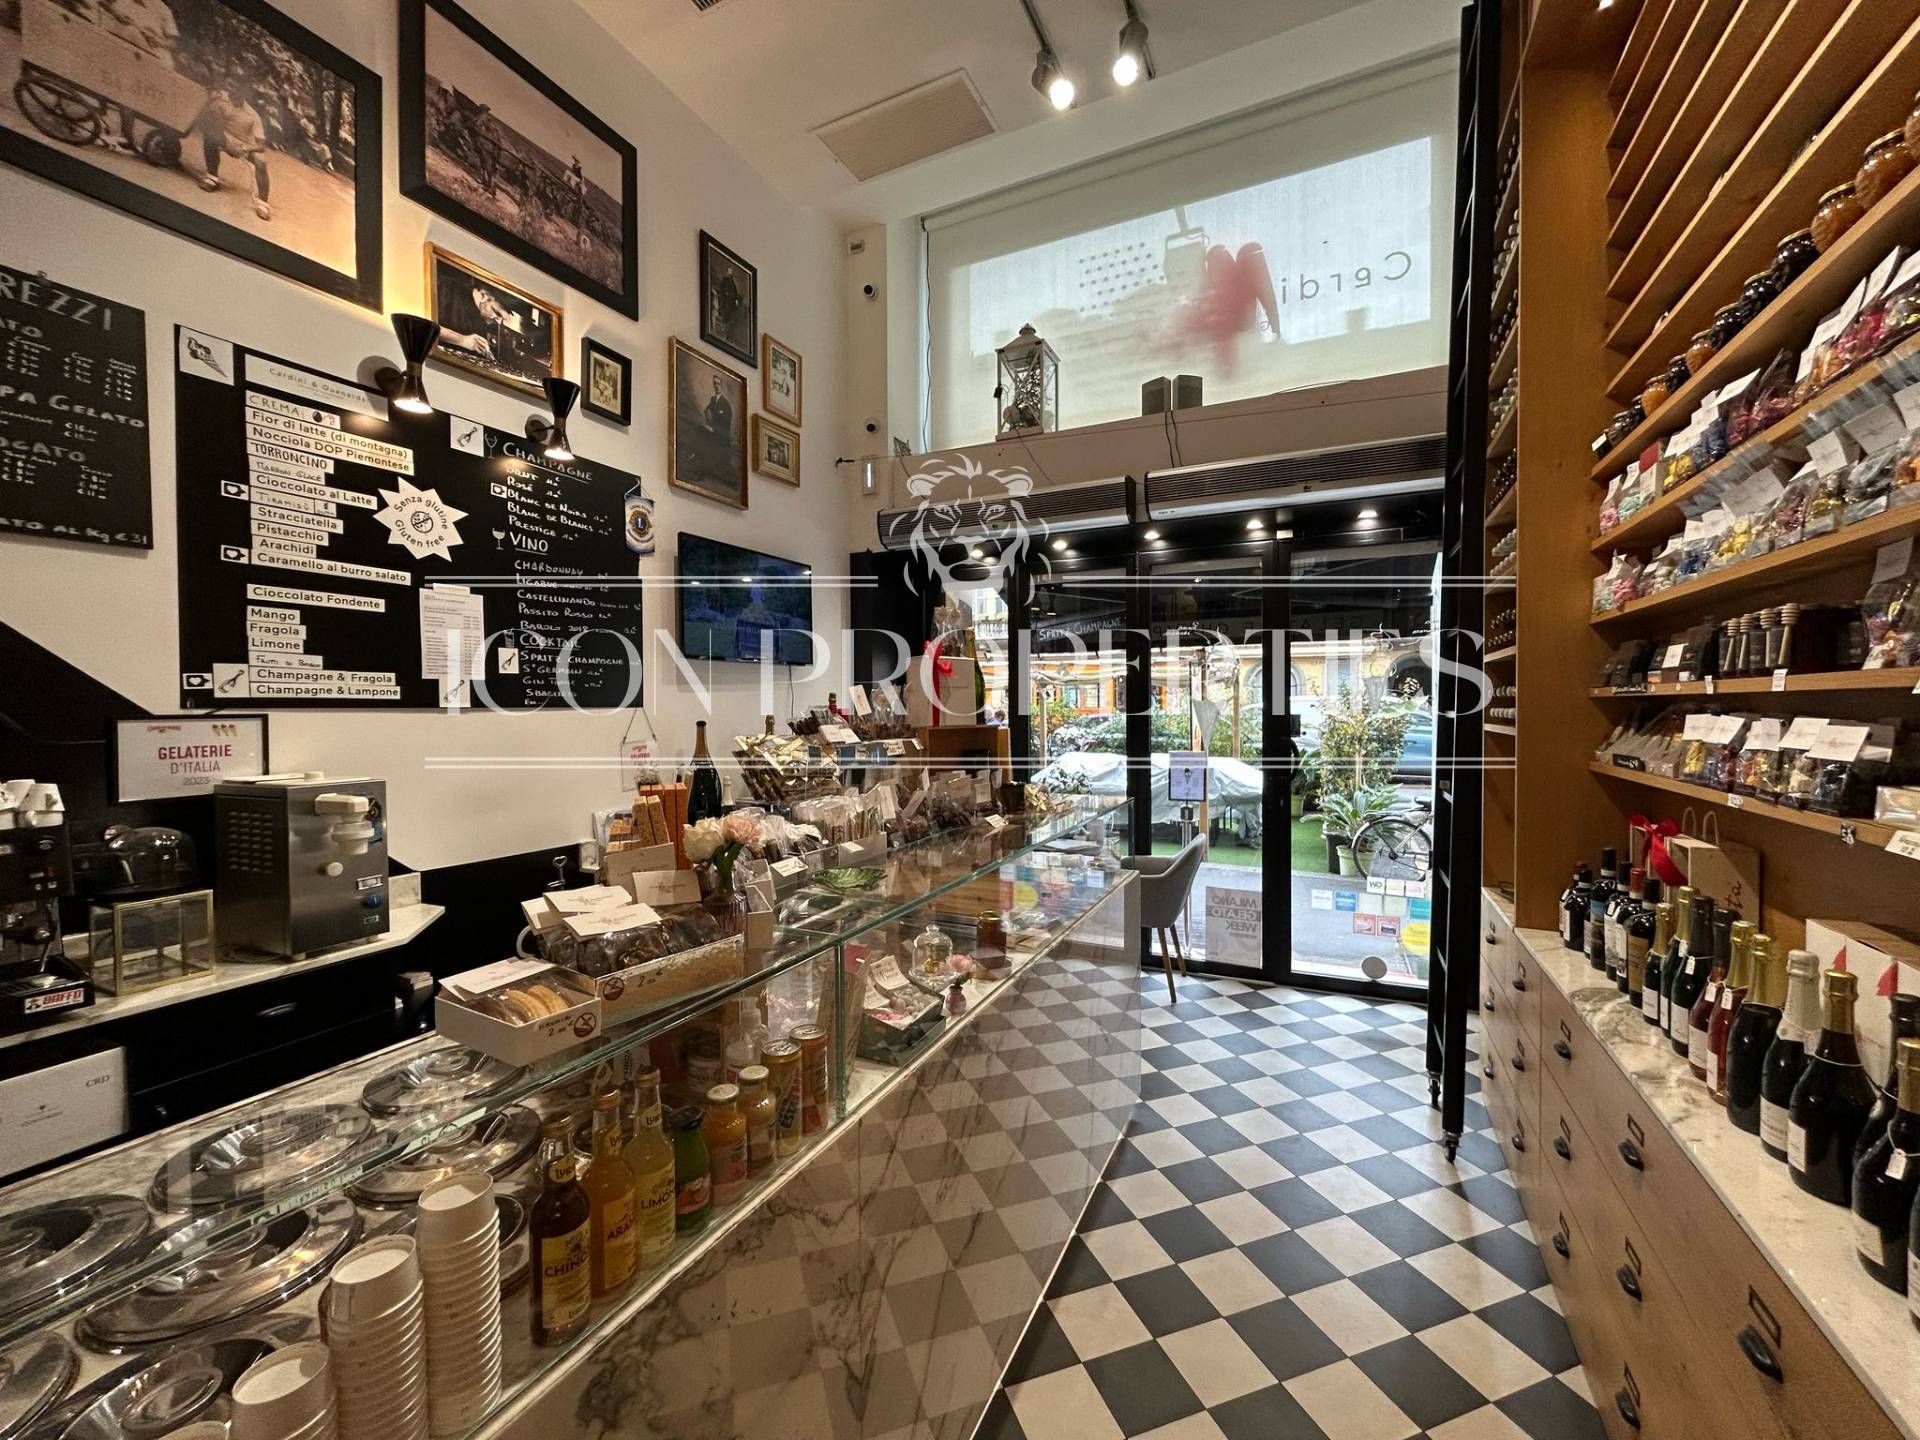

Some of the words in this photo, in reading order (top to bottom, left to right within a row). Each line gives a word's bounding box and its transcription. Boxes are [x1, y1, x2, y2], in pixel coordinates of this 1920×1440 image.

[249, 395, 300, 416] CREMA
[252, 411, 278, 425] Fior
[283, 419, 295, 430] di
[300, 424, 327, 438] latte
[331, 429, 346, 442] (di
[350, 437, 408, 458] montagna)
[250, 442, 328, 470] TORRONCINO
[252, 427, 311, 449] Nocciola
[314, 441, 343, 455] DOP
[346, 449, 410, 471] Piemontese
[256, 474, 326, 497] Cioccolato
[329, 489, 340, 500] al
[343, 493, 372, 506] Latte
[394, 496, 423, 512] Senza
[258, 507, 338, 530] Stracciatella
[424, 499, 448, 530] glutine
[257, 523, 324, 542] Pistacchio
[395, 519, 423, 548] Gluten
[425, 535, 445, 548] free
[510, 531, 548, 552] VINO
[259, 538, 314, 555] Arachidi
[257, 552, 323, 571] Caramello
[327, 561, 337, 572] al
[340, 563, 372, 577] burro
[375, 570, 407, 582] salato
[253, 586, 323, 603] Cioccolato
[327, 594, 381, 609] Fondente
[250, 607, 296, 624] Mango
[250, 622, 300, 639] Fragola
[251, 637, 300, 651] Limone
[257, 669, 334, 683] Champagne
[336, 673, 345, 682] &
[350, 672, 393, 686] Fragola
[256, 684, 333, 697] Champagne
[336, 686, 345, 695] &
[348, 686, 399, 699] Lampone
[158, 744, 232, 760] GELATERIE
[170, 760, 221, 775] D'ITALIA
[183, 776, 210, 786] 2023
